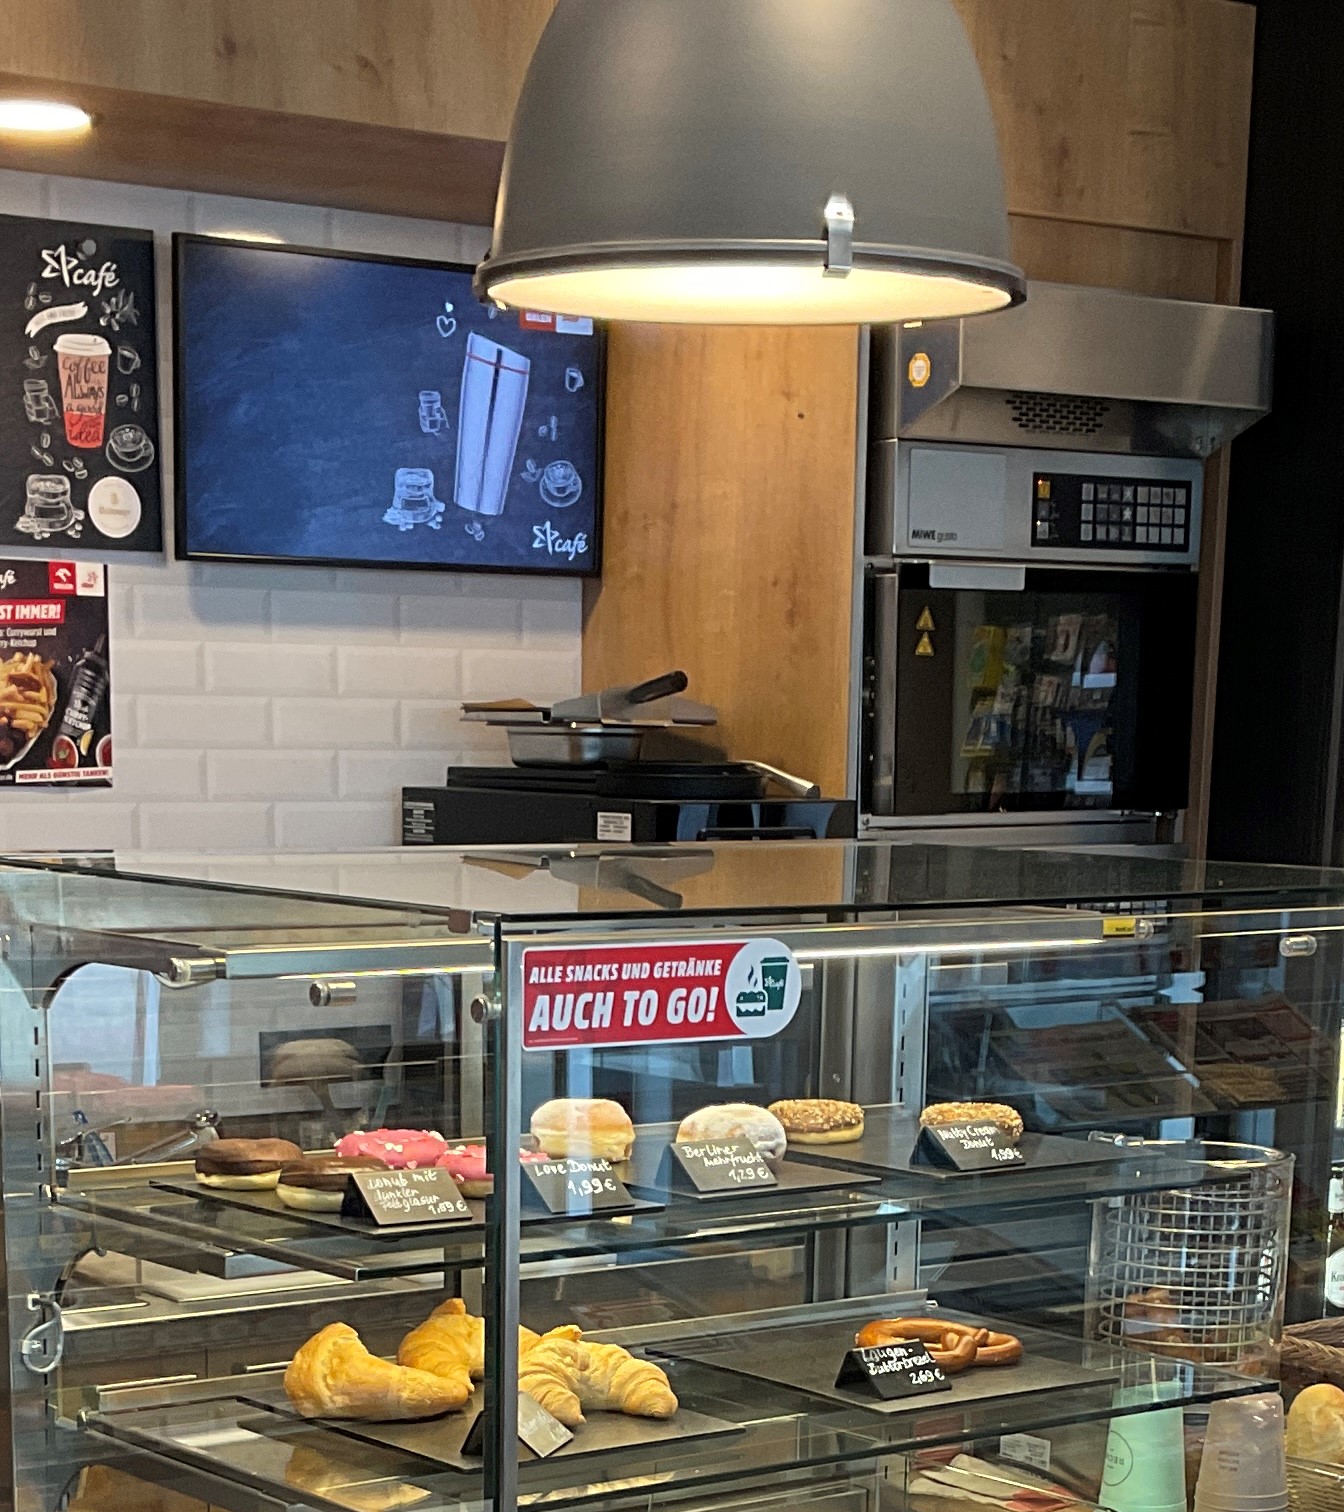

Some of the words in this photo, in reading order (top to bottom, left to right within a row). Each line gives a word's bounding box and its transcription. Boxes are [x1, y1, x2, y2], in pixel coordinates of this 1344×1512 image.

[72, 261, 120, 296] café
[911, 529, 936, 541] MIWE
[555, 533, 588, 560] café
[15, 603, 61, 619] IMMER!
[7, 628, 41, 638] Currywurst
[44, 628, 56, 636] und
[39, 771, 51, 779] ALS
[529, 964, 564, 984] ALLE
[566, 962, 619, 982] SNACKS
[622, 961, 649, 979] UND
[652, 957, 723, 978] GETRÄNKE
[529, 990, 616, 1033] AUCH
[623, 989, 658, 1028] TO
[667, 985, 719, 1024] GO!
[684, 1142, 741, 1159] Berliner
[960, 1136, 994, 1150] Donut
[533, 1162, 566, 1178] Love
[567, 1159, 613, 1175] Donut
[727, 1165, 769, 1182] 1,29€
[567, 1177, 617, 1196] 1,99€
[860, 1346, 914, 1363] Laugen-
